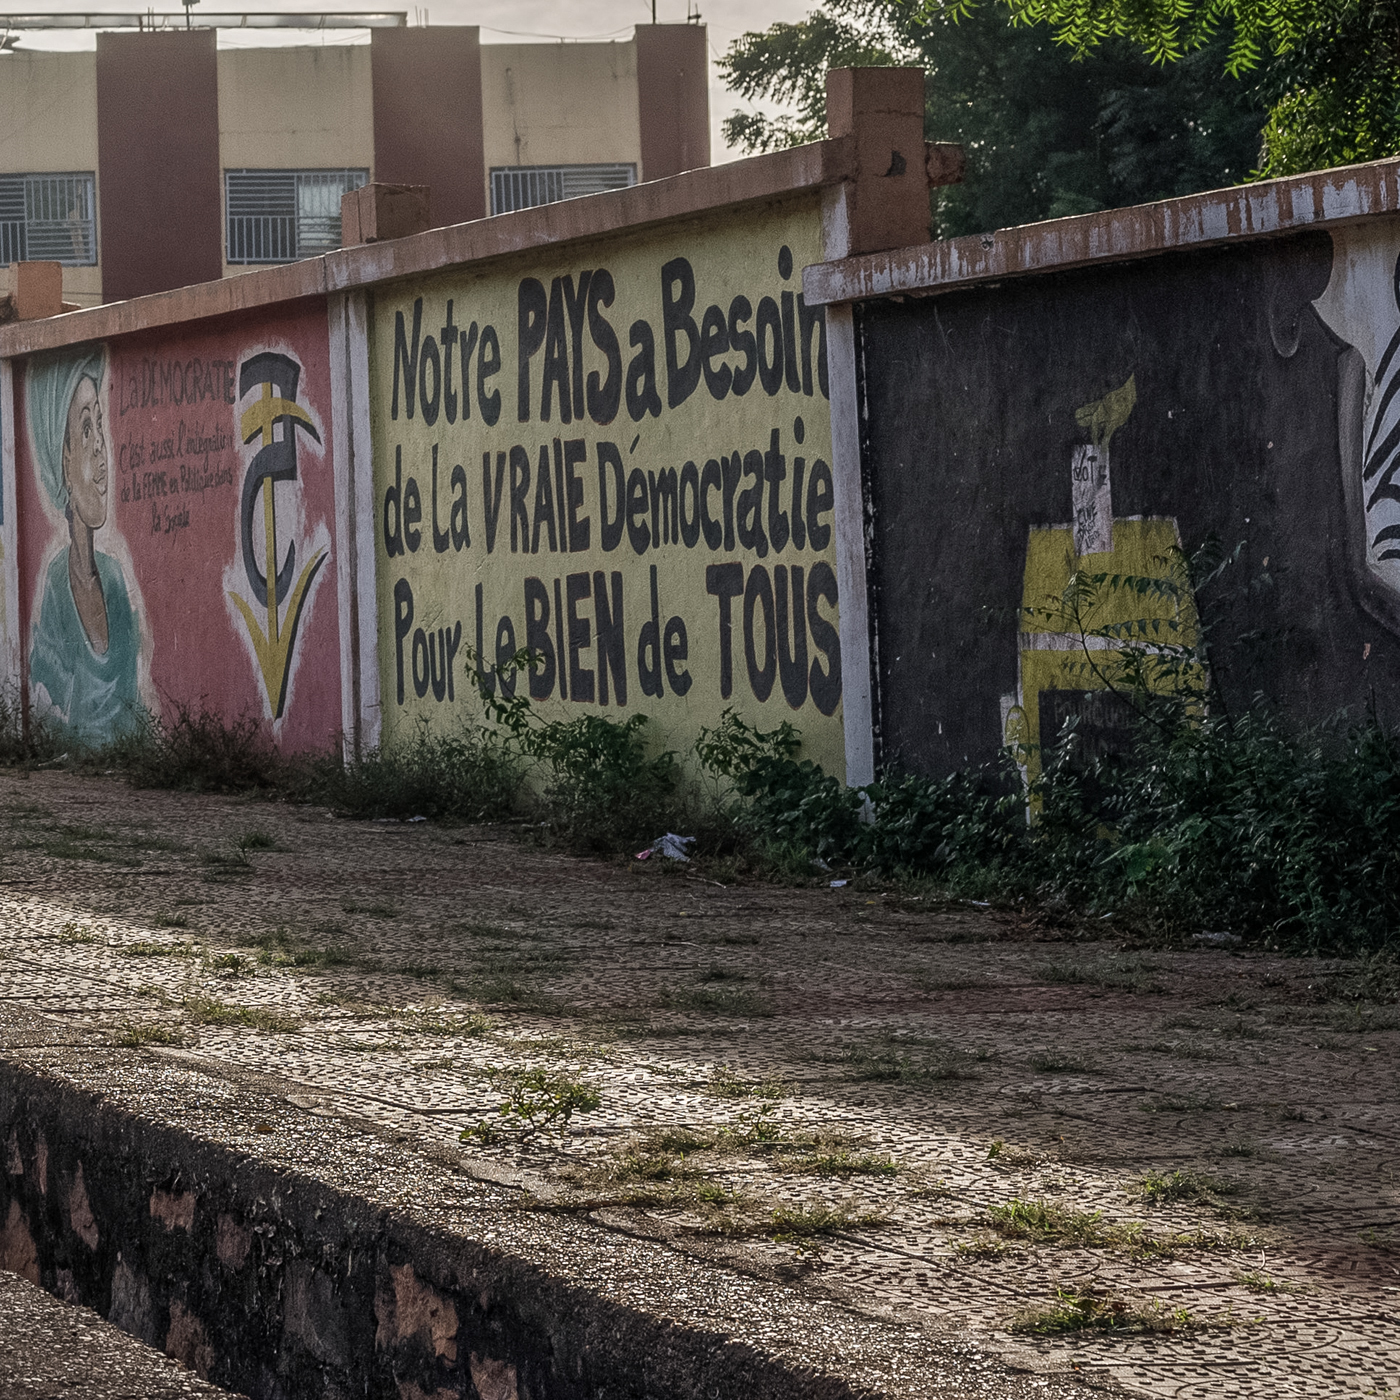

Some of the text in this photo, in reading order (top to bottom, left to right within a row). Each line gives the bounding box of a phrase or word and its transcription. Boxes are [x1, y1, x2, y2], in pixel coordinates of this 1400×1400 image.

[391, 244, 831, 427] Notre PAYS a Besoin
[383, 444, 422, 558] de
[482, 437, 591, 554] VRAIE
[596, 416, 836, 559] Démocratie
[393, 577, 463, 707] Pour
[524, 570, 628, 707] BIEN
[637, 564, 693, 700] de
[705, 561, 844, 718] TOUS
